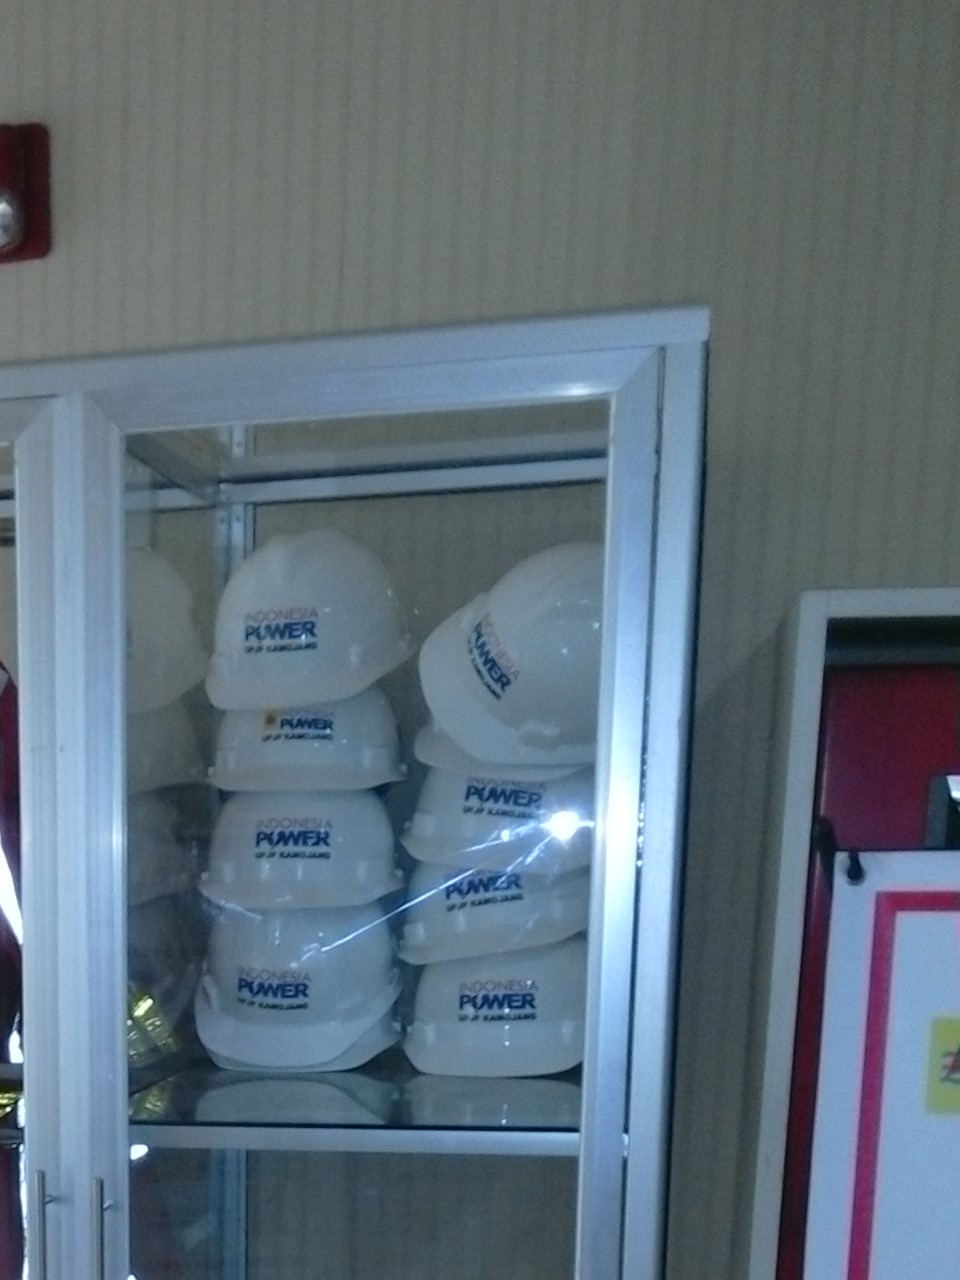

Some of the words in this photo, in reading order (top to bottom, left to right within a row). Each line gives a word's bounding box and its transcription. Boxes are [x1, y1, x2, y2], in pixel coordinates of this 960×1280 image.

[245, 620, 318, 641] POWER
[280, 718, 334, 732] POWER
[465, 785, 543, 808] POWER
[256, 829, 331, 847] POWER
[238, 978, 310, 999] POWER
[459, 993, 537, 1010] POWER
